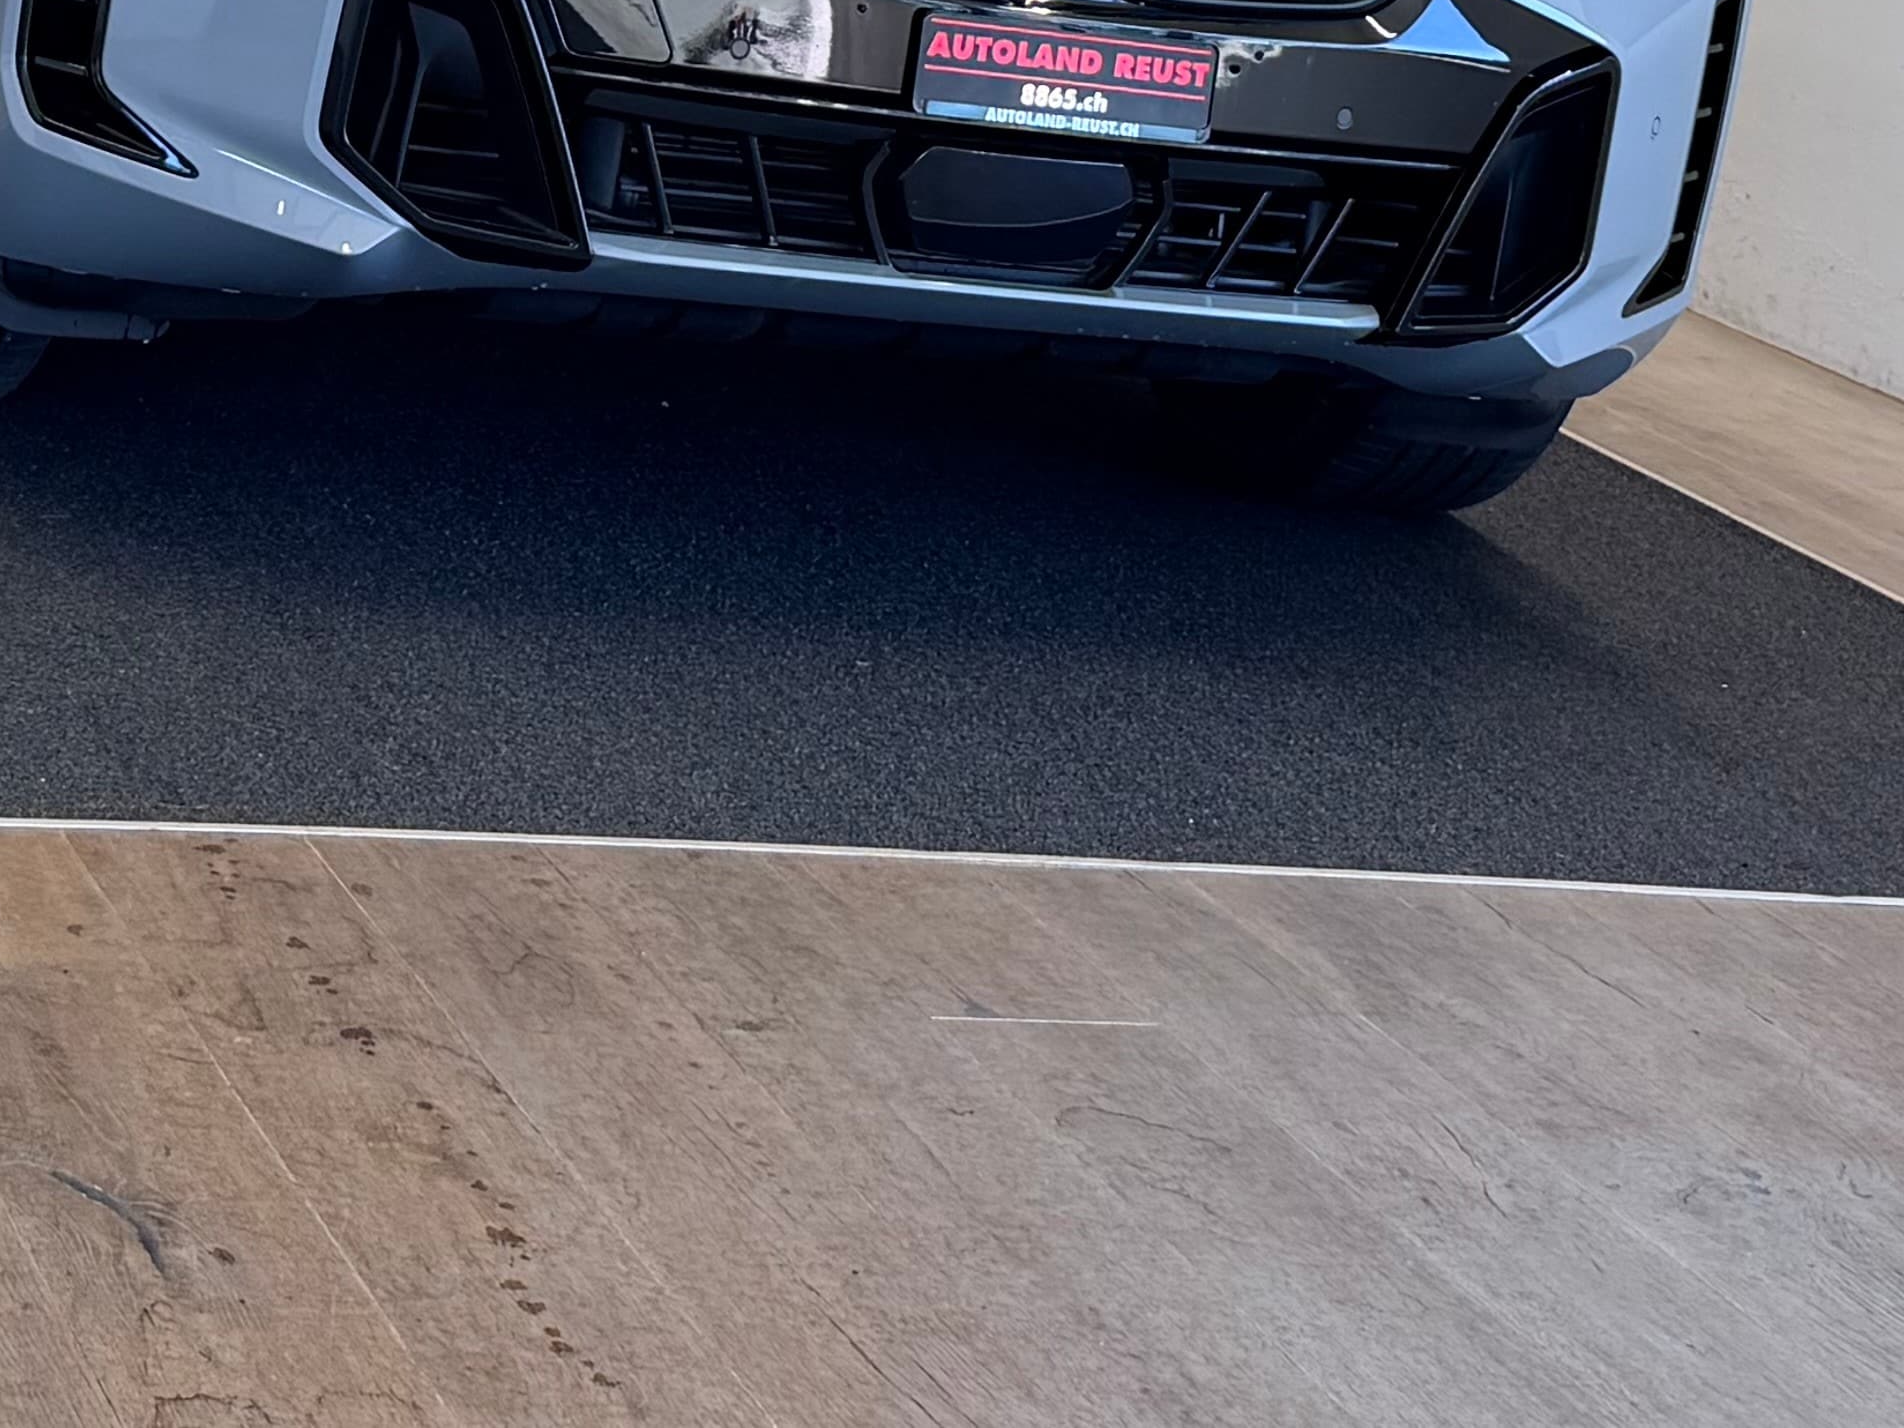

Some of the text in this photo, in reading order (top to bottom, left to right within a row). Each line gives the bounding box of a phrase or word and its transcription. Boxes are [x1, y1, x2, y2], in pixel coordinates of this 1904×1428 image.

[927, 32, 1211, 87] AUTOLAND REUST
[1020, 83, 1108, 113] 8865.ch
[985, 107, 1140, 137] AUTOLAND-REUST.CH
